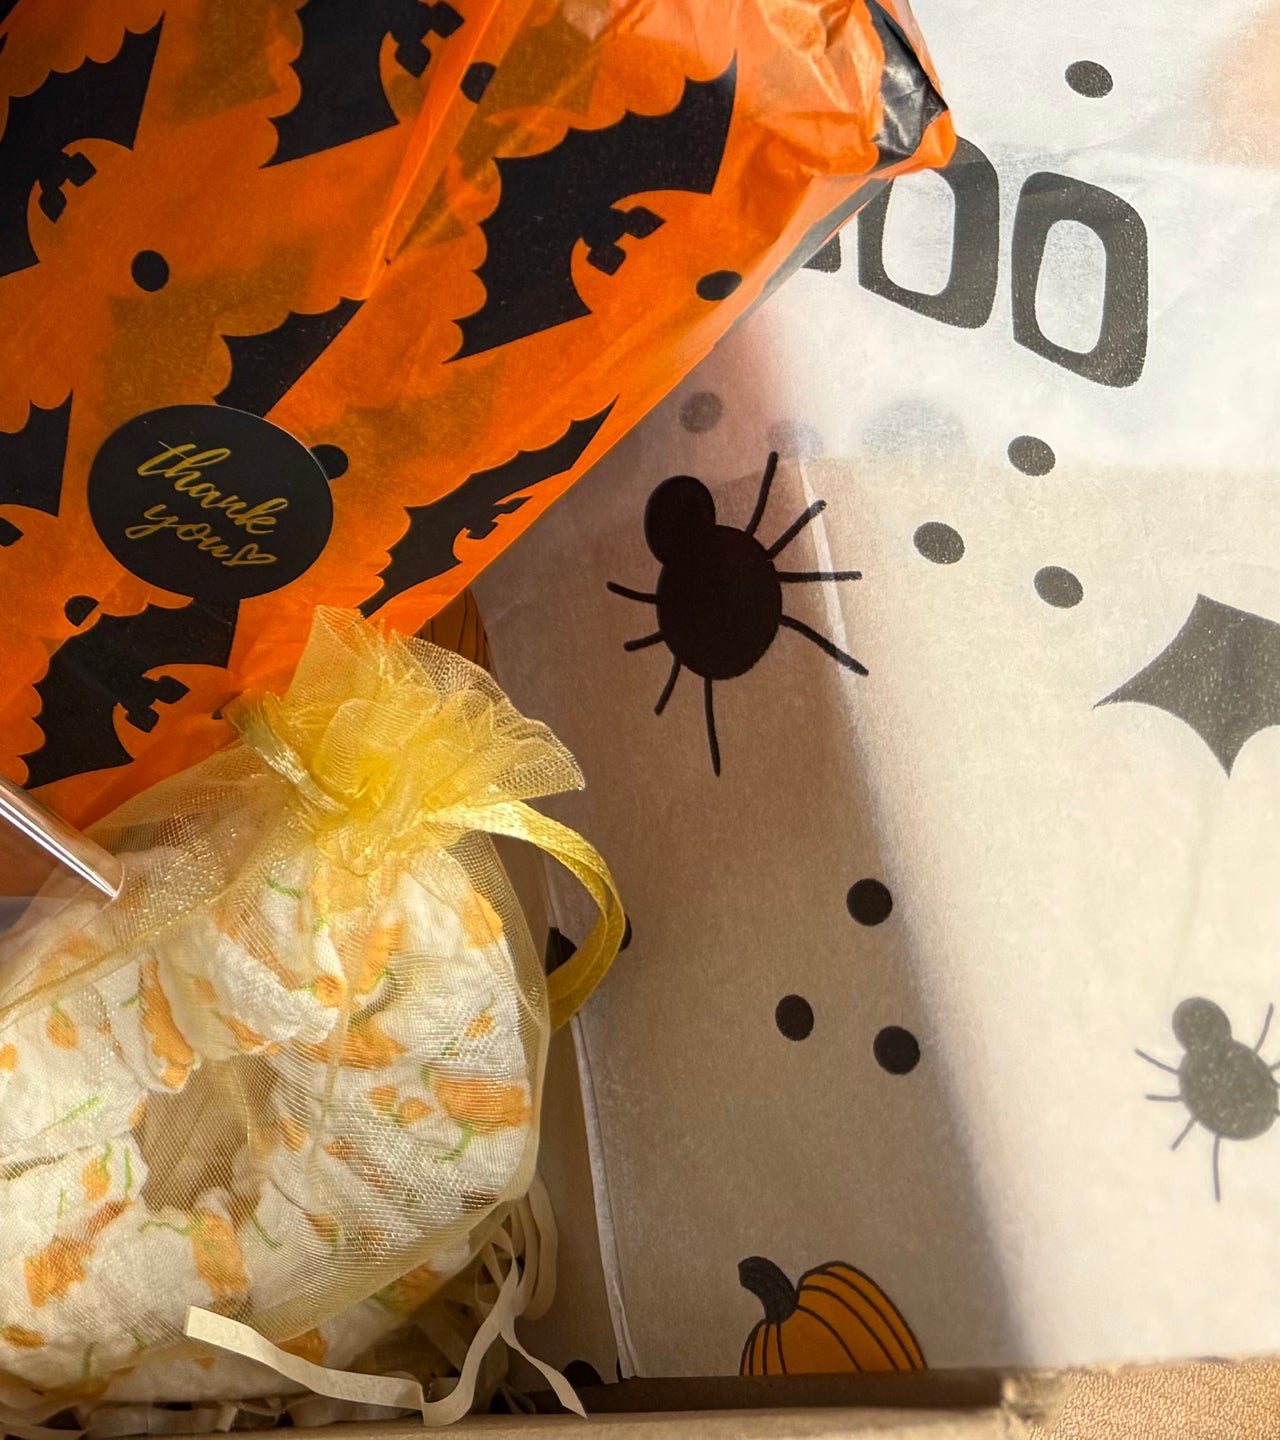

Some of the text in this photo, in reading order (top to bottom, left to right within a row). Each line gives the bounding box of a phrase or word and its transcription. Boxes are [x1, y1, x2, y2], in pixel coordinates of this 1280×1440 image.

[802, 134, 1149, 389] OO
[124, 503, 233, 558] you
[137, 440, 289, 535] thank
